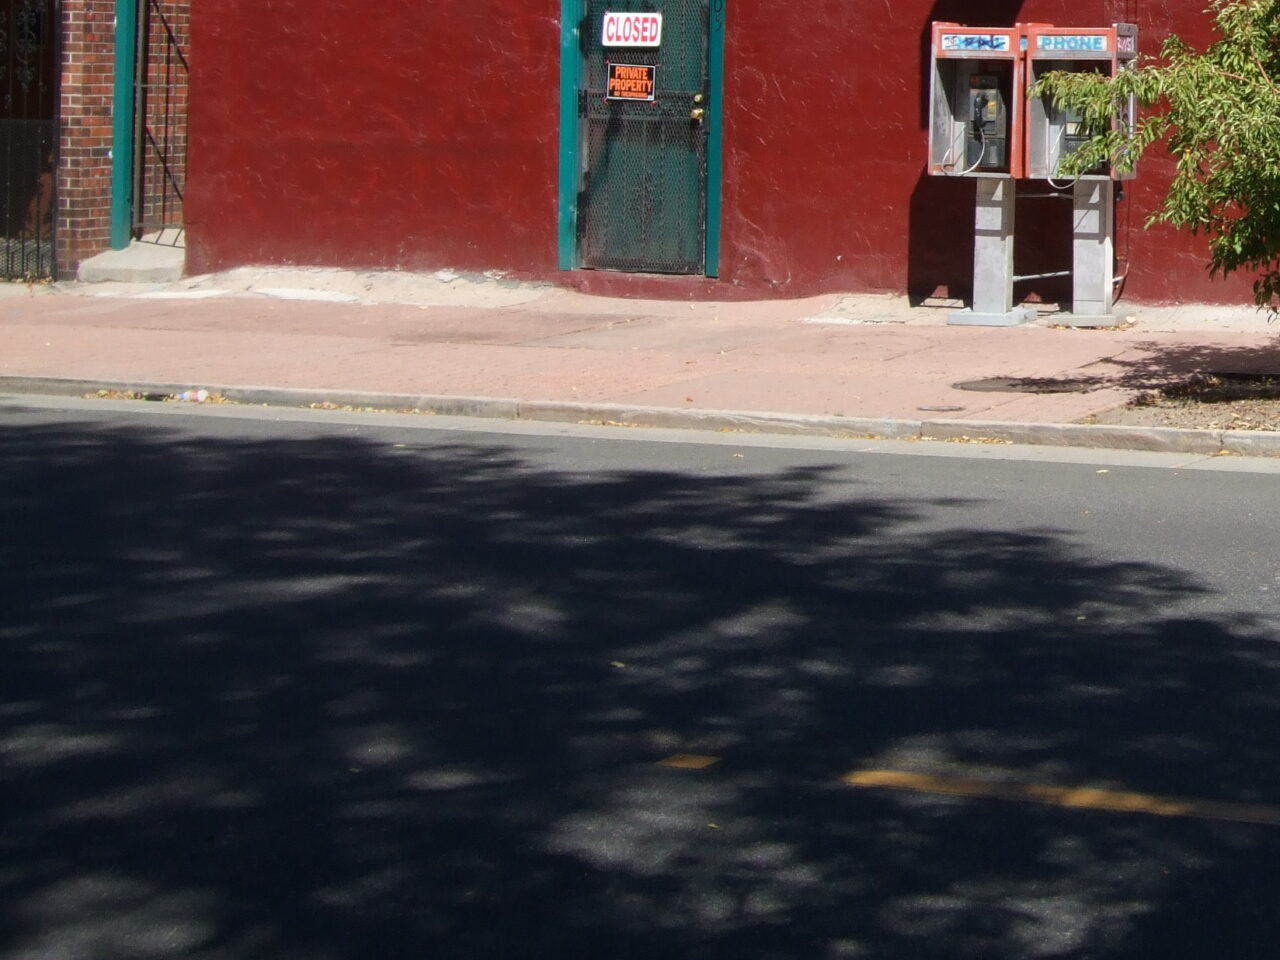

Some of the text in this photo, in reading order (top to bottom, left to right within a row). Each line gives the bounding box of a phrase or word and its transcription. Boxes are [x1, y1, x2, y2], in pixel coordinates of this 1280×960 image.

[606, 16, 659, 42] CLOSED
[1042, 36, 1104, 50] PHONE
[615, 66, 648, 79] PRIVATE
[610, 78, 652, 91] PROPERTY
